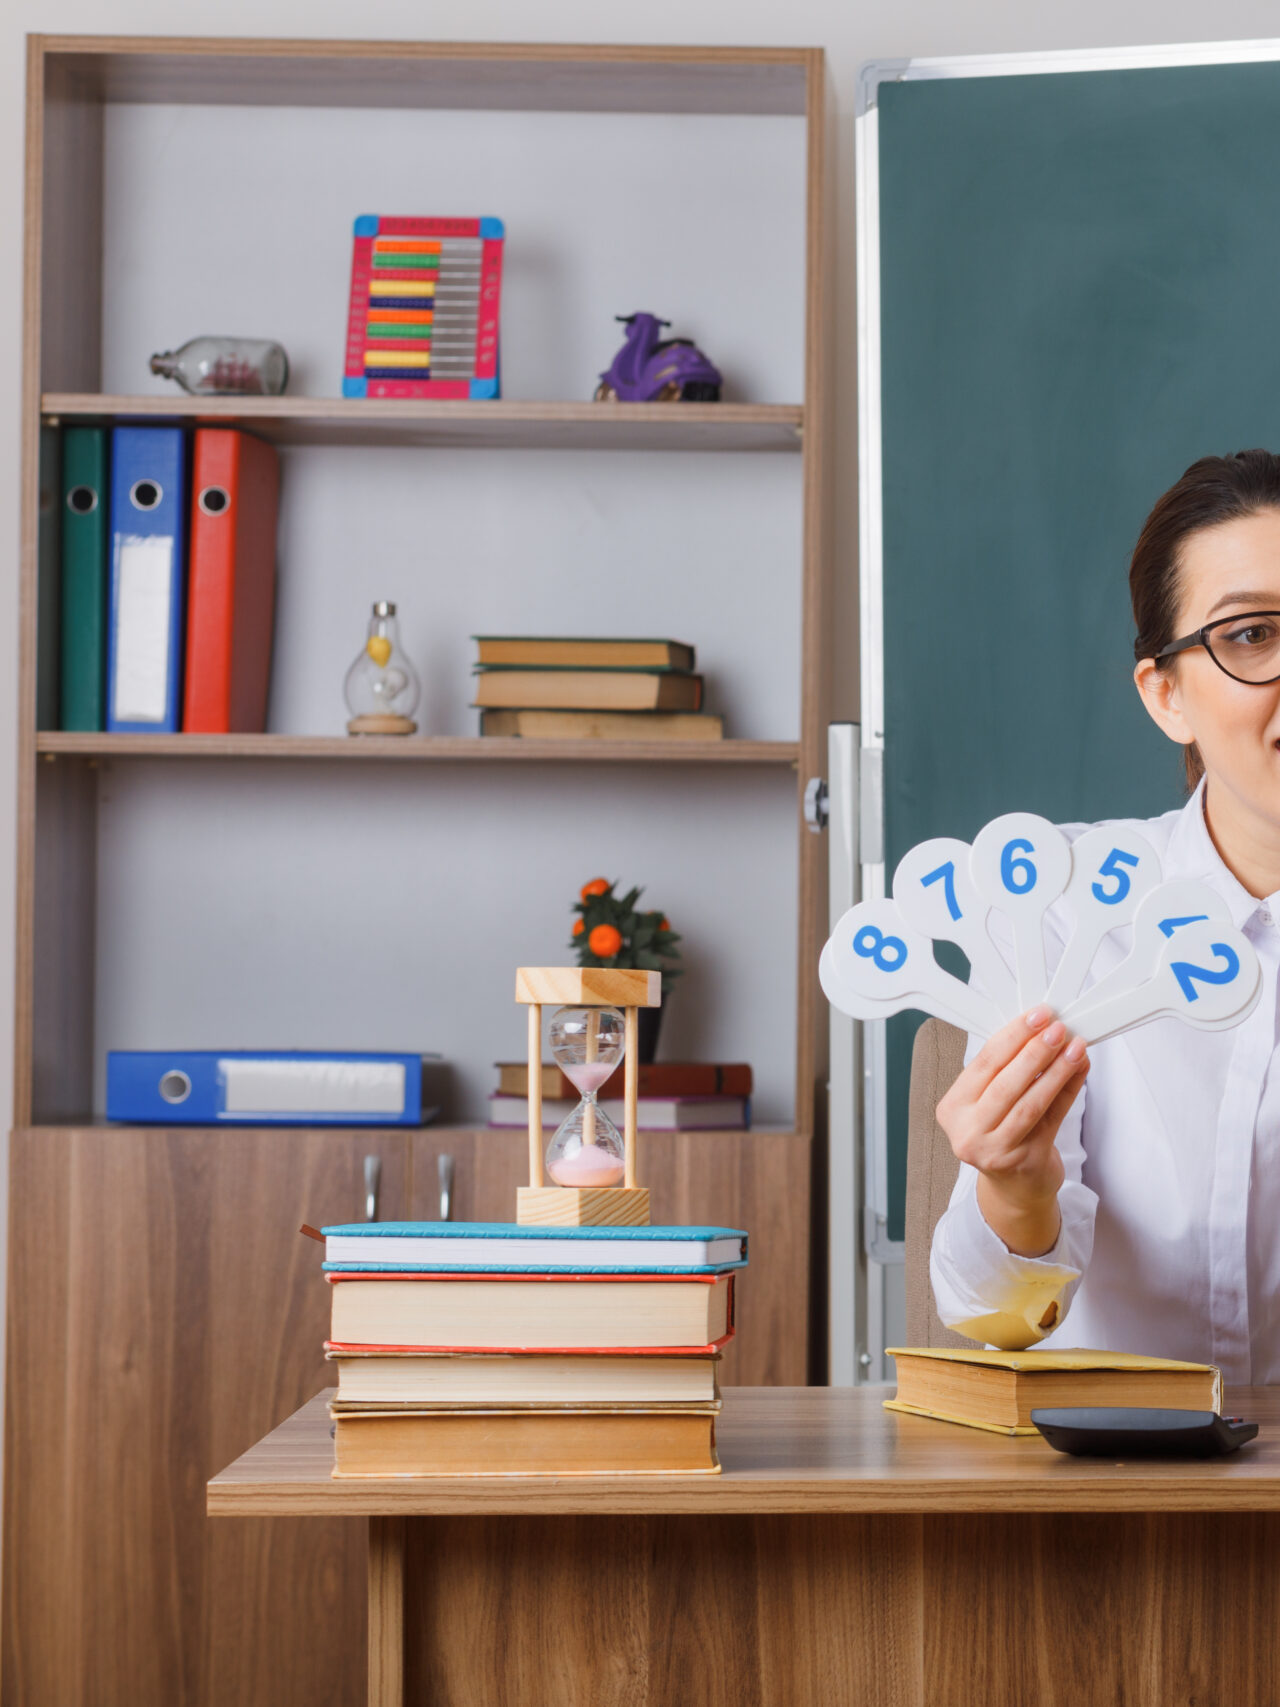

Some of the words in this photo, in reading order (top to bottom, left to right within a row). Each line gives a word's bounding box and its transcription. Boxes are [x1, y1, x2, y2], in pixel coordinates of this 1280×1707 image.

[919, 860, 963, 922] 7
[1000, 838, 1038, 896] 6
[1091, 847, 1140, 906] 5
[852, 924, 909, 973] 8
[1169, 942, 1241, 1003] 2
